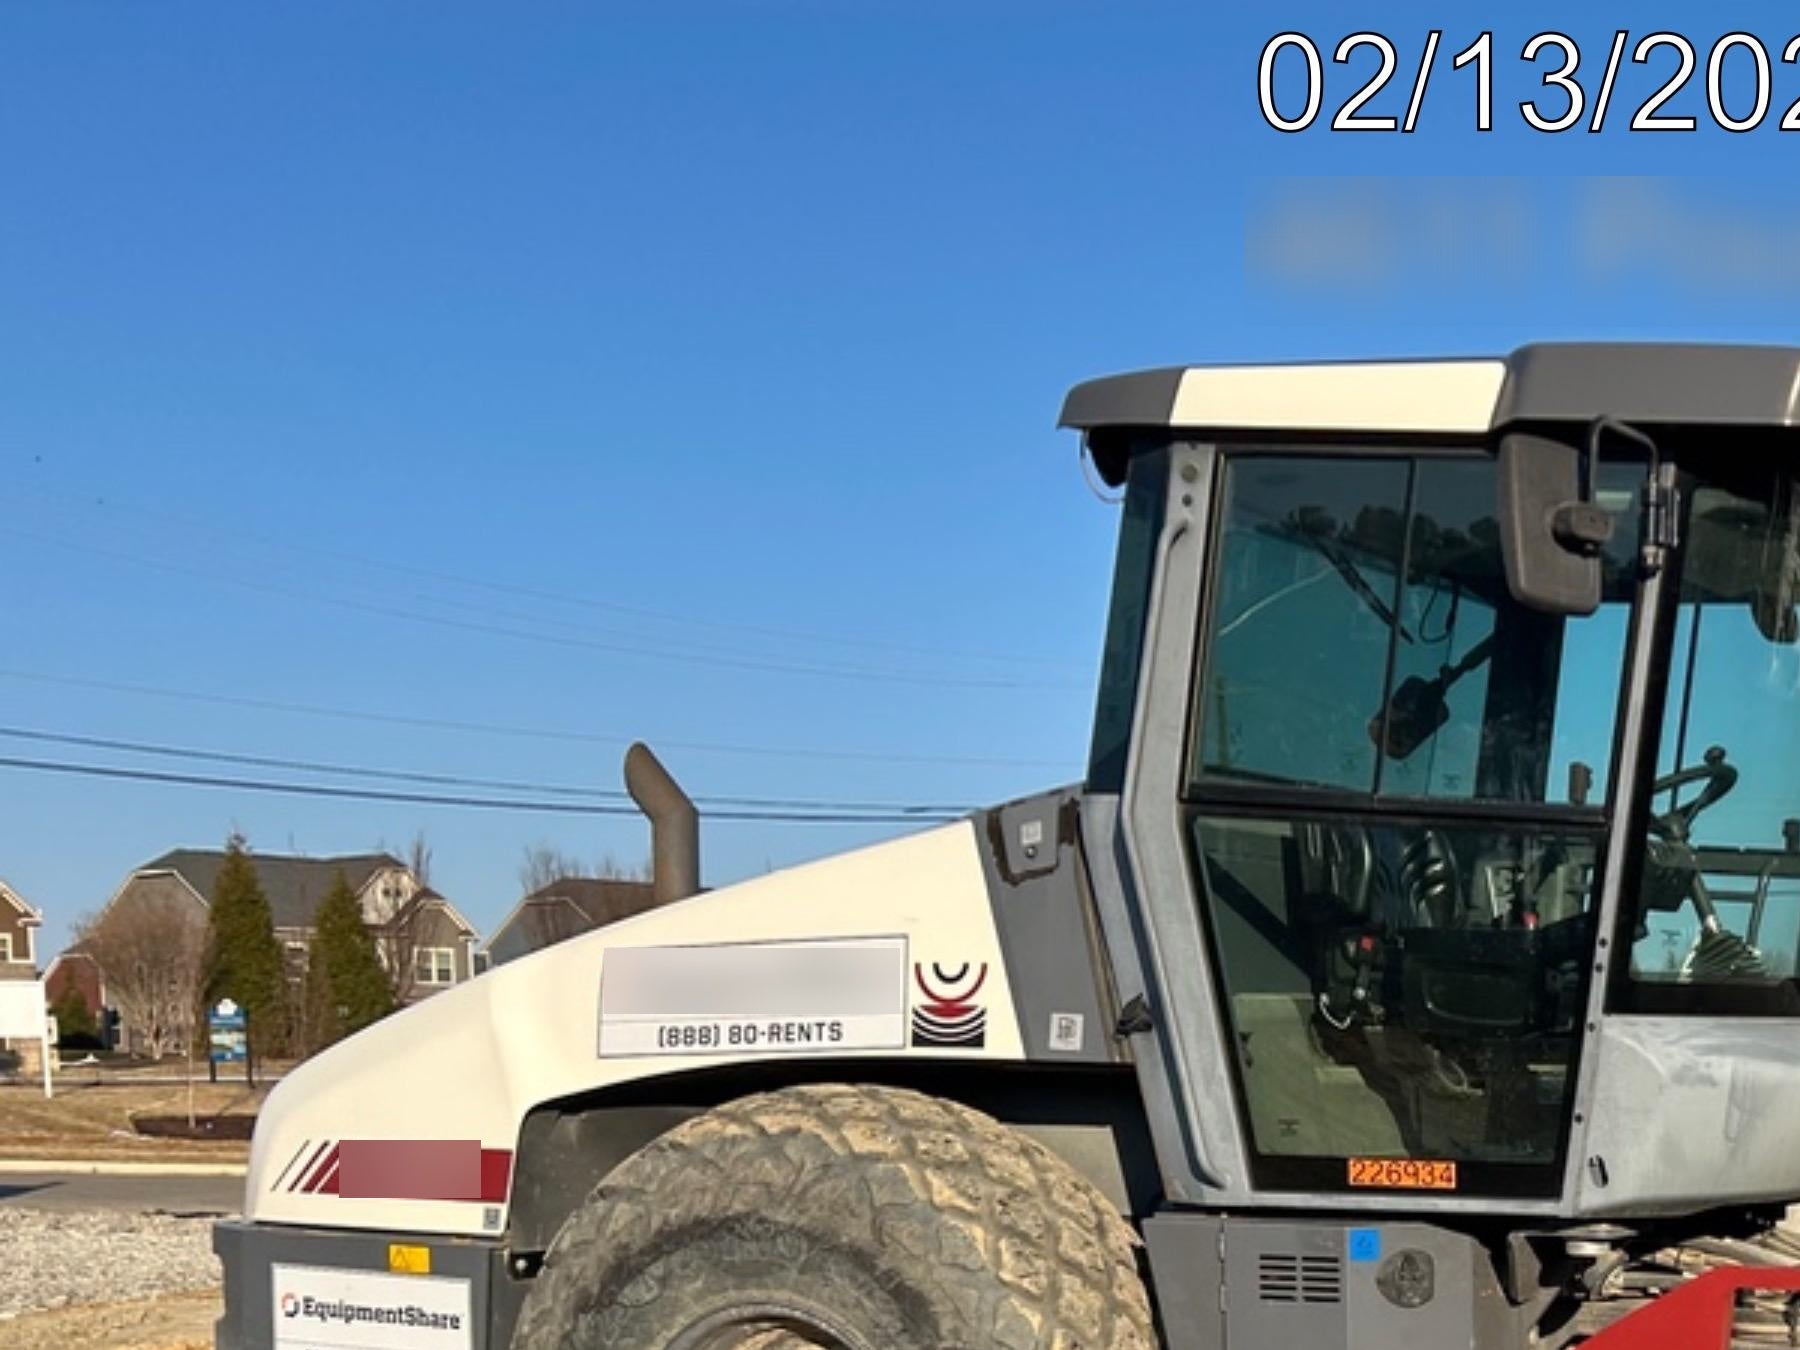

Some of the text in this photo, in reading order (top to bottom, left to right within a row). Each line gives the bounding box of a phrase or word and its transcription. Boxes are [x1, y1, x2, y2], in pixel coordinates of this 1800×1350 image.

[658, 1021, 844, 1048] (888) 80-RENTS
[1351, 1160, 1454, 1185] 226934
[302, 1295, 461, 1330] EquipmentShare
